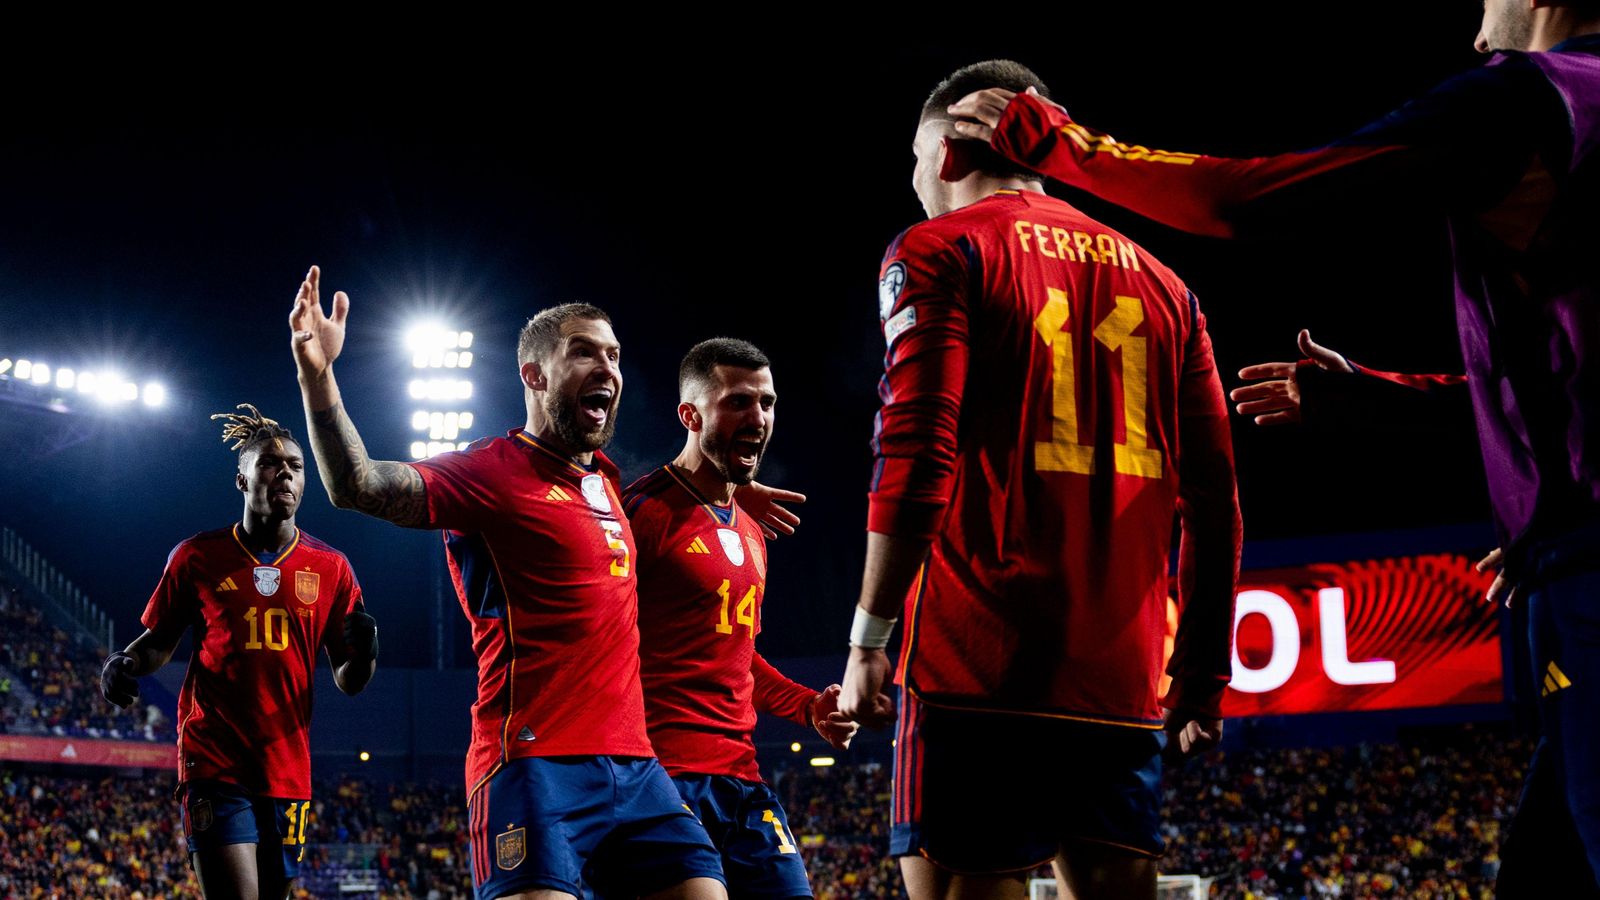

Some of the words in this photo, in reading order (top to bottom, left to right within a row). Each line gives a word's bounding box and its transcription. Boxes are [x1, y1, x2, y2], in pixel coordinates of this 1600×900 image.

[1015, 220, 1141, 272] FERRAN
[1034, 286, 1163, 480] 11
[602, 520, 630, 577] 5
[243, 606, 289, 651] 10
[715, 579, 758, 640] 14
[762, 809, 798, 855] 1
